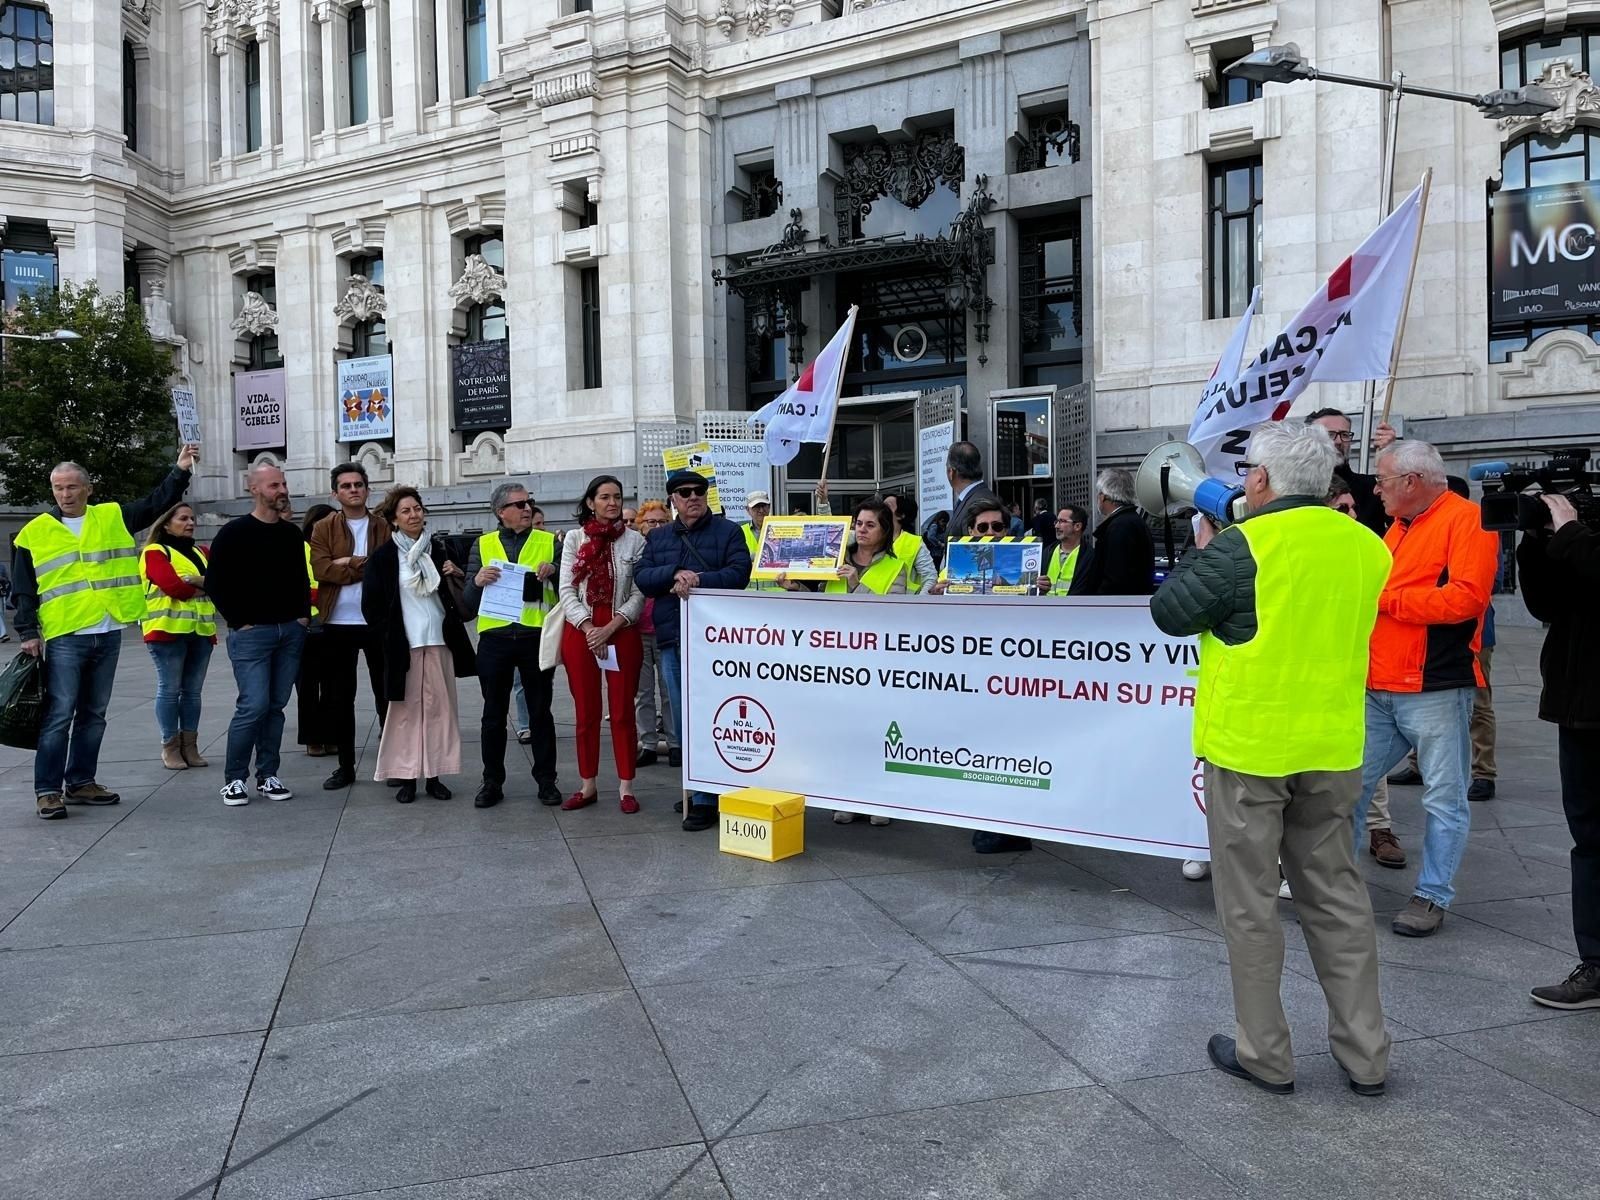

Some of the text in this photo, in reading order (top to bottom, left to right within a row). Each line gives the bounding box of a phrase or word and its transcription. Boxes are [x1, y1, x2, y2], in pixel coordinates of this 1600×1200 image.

[1519, 304, 1543, 314] LIMO
[459, 375, 508, 386] NOTRE-DAME
[479, 384, 499, 395] PARÍS
[247, 393, 270, 404] VIDA
[241, 403, 280, 416] PALACIO
[245, 414, 280, 427] CIBELES
[705, 624, 1200, 665] CANTÓN Y SELUR LEJOS DE COLEGIOS Y VIV
[712, 659, 1196, 707] CON CONSENSO VECINAL. CUMPLAN SU PR
[713, 727, 775, 746] CANTÓN
[727, 745, 761, 753] MONTECARMELO
[885, 740, 1053, 776] MonteCarmelo
[962, 771, 1040, 787] asociación vecinal
[726, 819, 767, 840] 14.000
